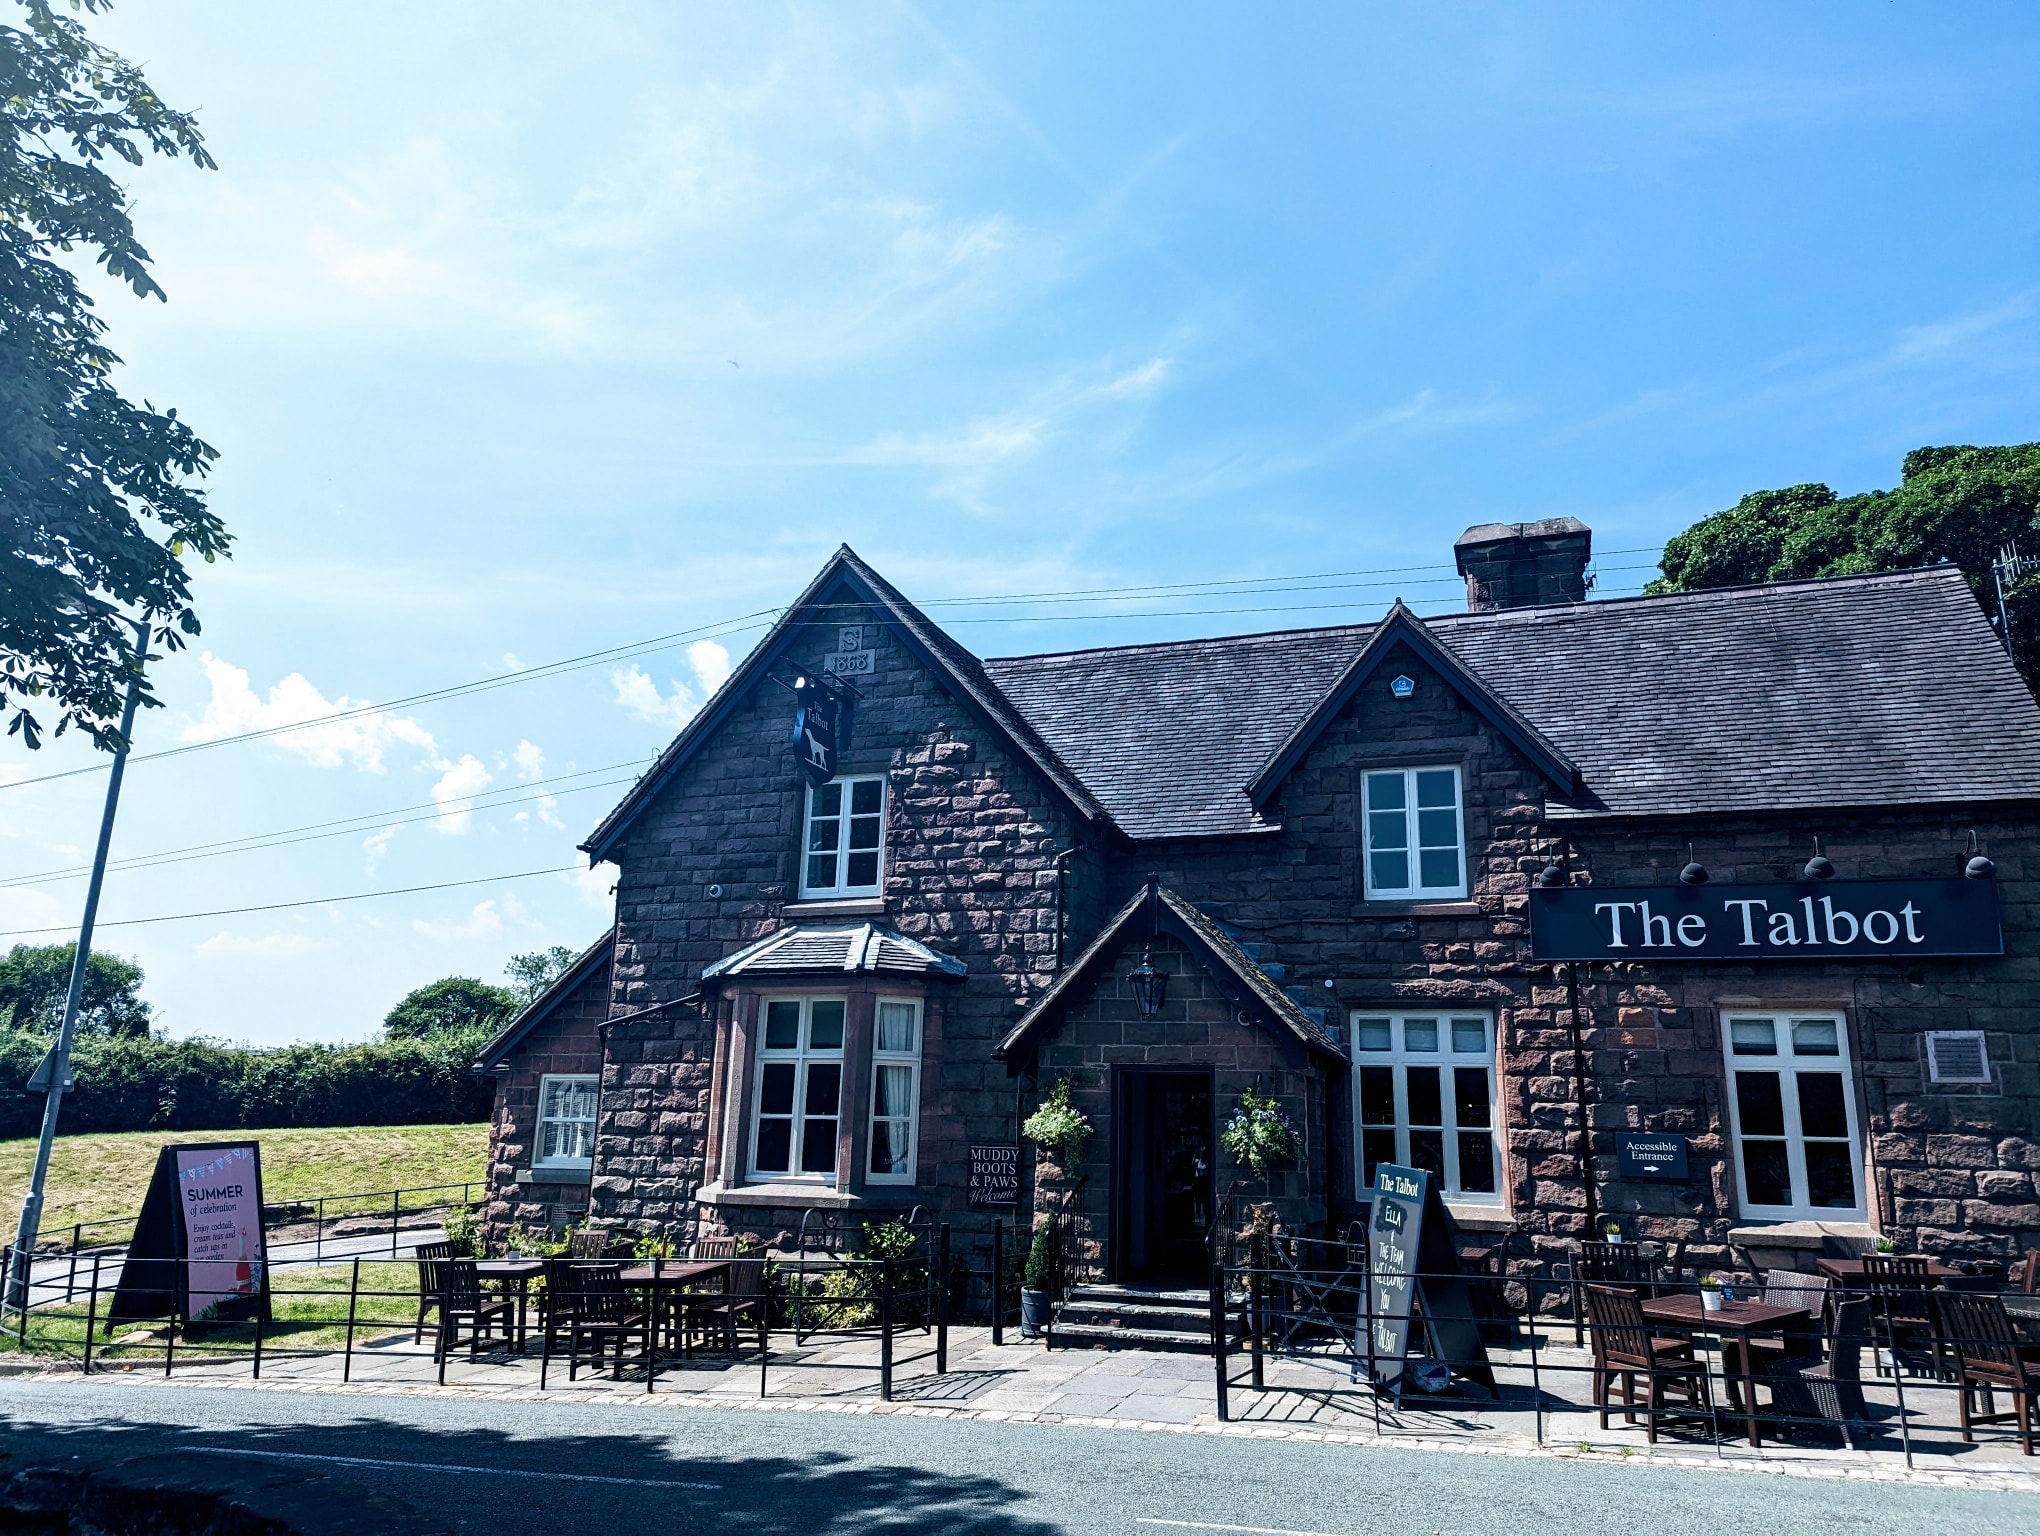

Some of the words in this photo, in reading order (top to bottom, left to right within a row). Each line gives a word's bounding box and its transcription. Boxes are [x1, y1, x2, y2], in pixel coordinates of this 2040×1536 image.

[814, 700, 823, 713] The
[808, 707, 829, 731] Talbot
[1594, 899, 1707, 948] The
[1724, 895, 1925, 946] Talbot
[1626, 1141, 1678, 1152] Accessible
[970, 1148, 1020, 1161] MUDDY
[1631, 1151, 1674, 1161] Entrance
[973, 1162, 1016, 1175] BOOTS
[970, 1174, 980, 1187] &
[984, 1175, 1018, 1188] PAWS
[1380, 1173, 1395, 1192] The
[1395, 1176, 1419, 1197] Talbot
[187, 1184, 244, 1202] SUMMER
[969, 1187, 1017, 1204] Welcome
[190, 1204, 198, 1217] of
[199, 1202, 237, 1215] celebration
[1385, 1205, 1401, 1228] ELLA
[193, 1223, 210, 1234] Enjoy
[193, 1235, 211, 1243] cream
[212, 1233, 224, 1241] teas
[224, 1229, 236, 1239] and
[193, 1242, 209, 1254] catch
[210, 1243, 221, 1254] ups
[221, 1241, 228, 1250] in
[1379, 1241, 1390, 1260] THE
[1390, 1245, 1404, 1270] TEAM
[1374, 1261, 1407, 1291] WELCOME
